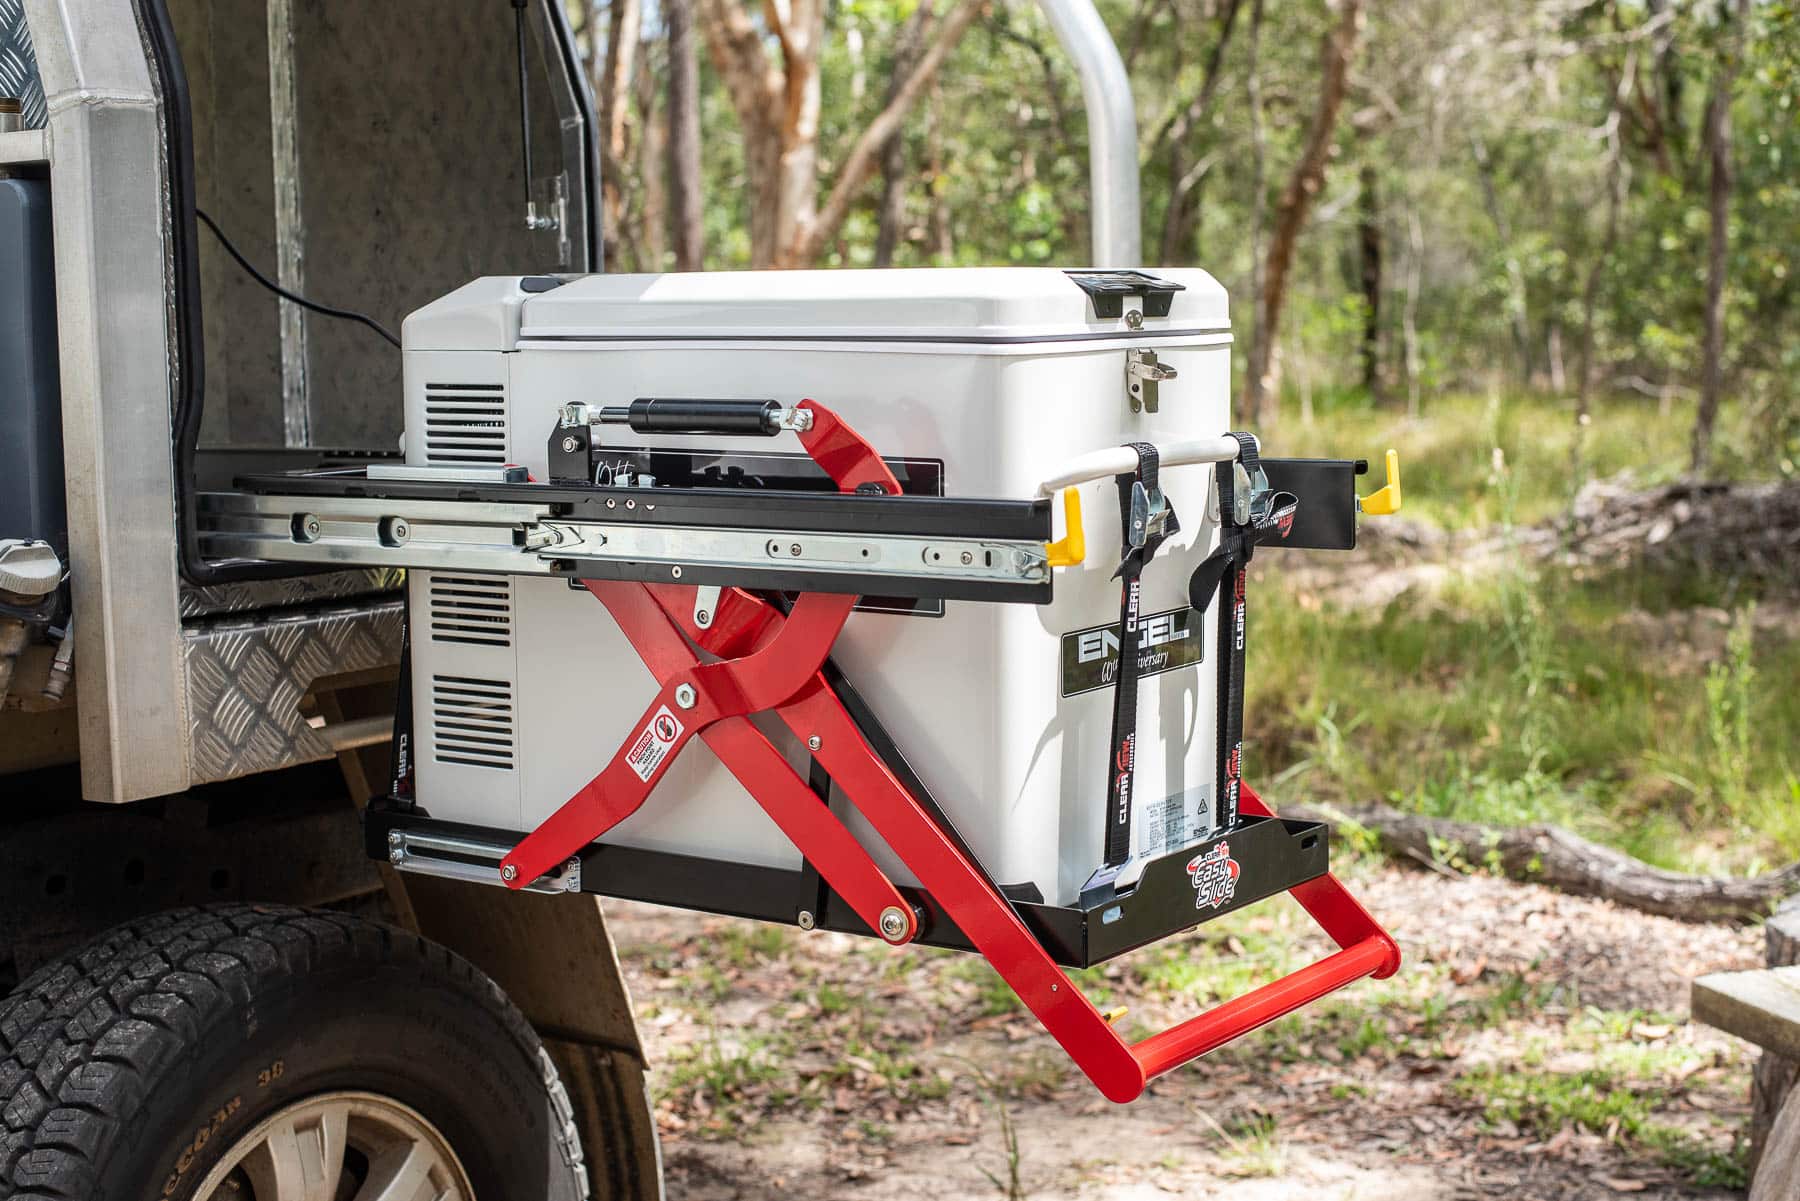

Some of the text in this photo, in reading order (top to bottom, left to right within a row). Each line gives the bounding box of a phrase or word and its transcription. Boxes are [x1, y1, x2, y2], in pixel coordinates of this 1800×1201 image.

[1126, 579, 1140, 633] CLEAR
[1138, 650, 1169, 669] iversary
[633, 733, 652, 757] CAUTION
[1116, 739, 1130, 824] CLEARVIEW
[1226, 749, 1240, 826] CLEARVIEW
